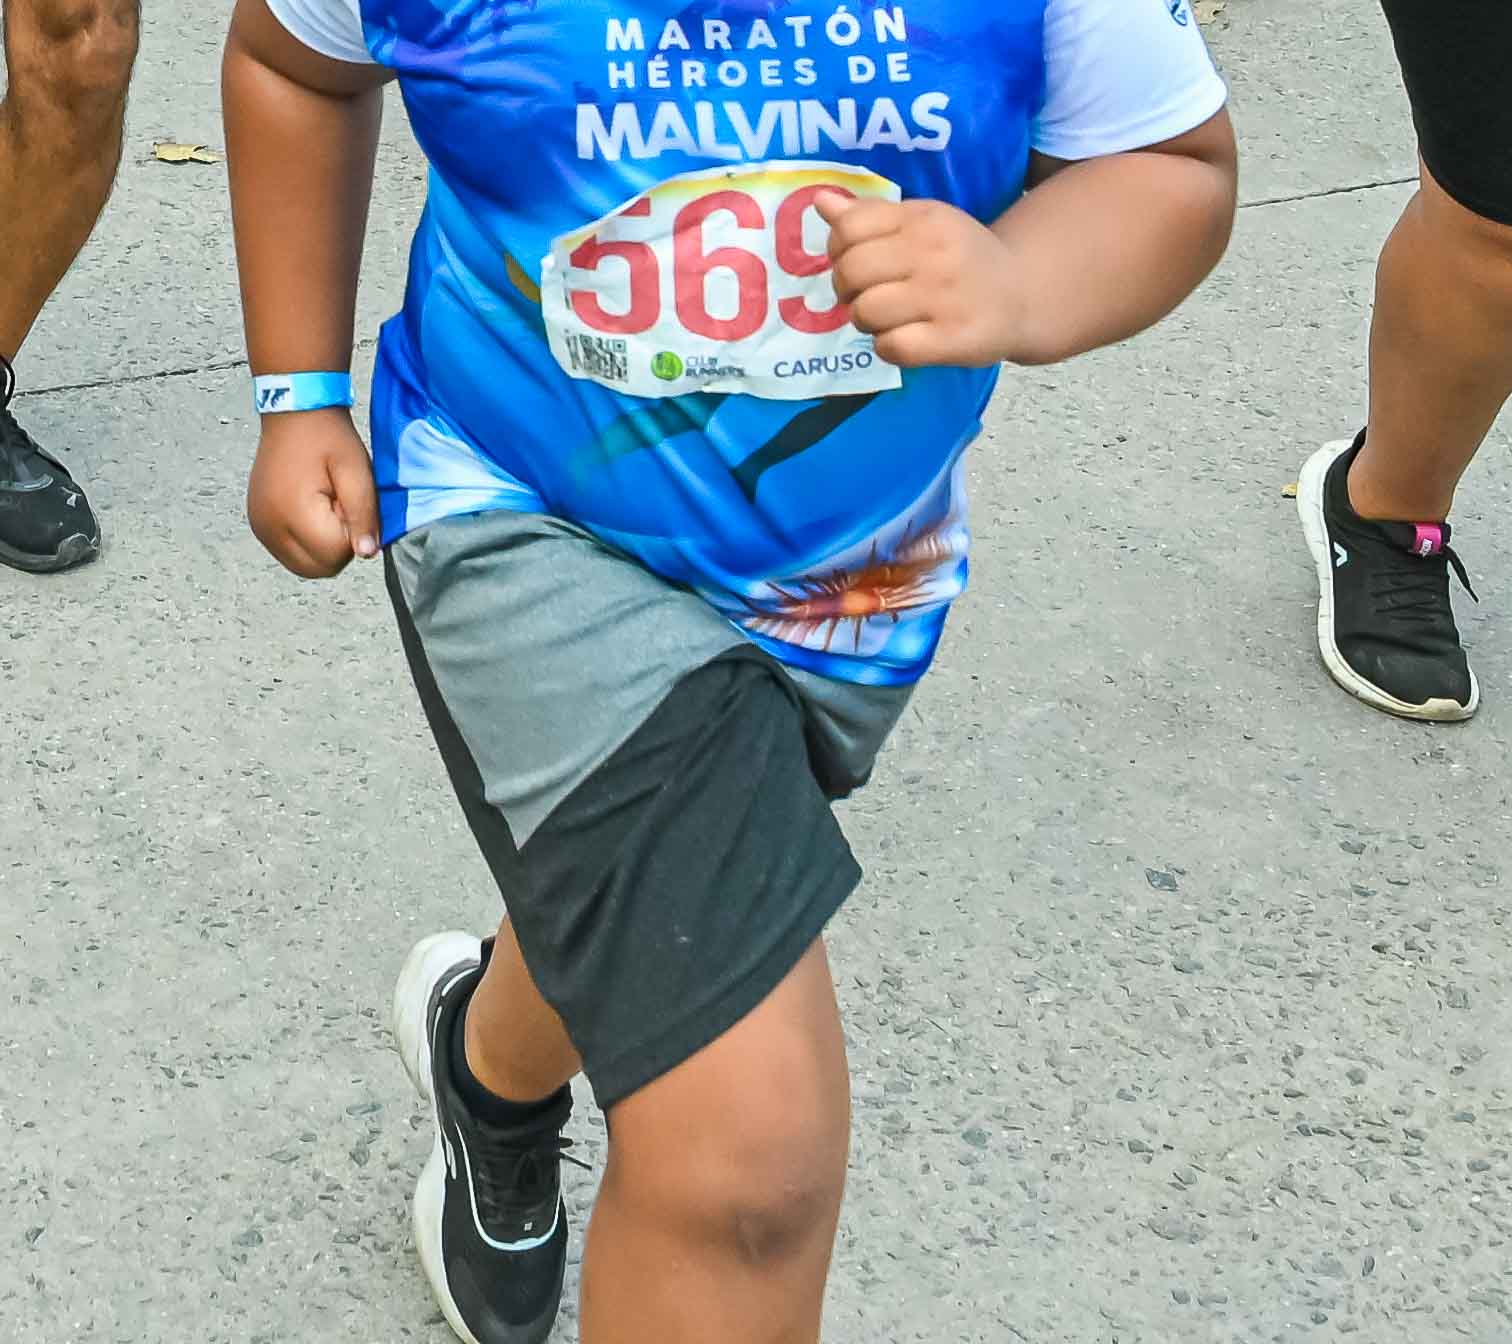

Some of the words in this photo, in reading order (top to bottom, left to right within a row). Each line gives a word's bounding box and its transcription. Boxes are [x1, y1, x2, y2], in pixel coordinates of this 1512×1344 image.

[606, 4, 910, 53] MARATÓN
[608, 55, 822, 90] HÉROES
[847, 52, 915, 84] DE
[576, 92, 954, 161] MALVINAS
[569, 184, 860, 342] 569
[773, 350, 874, 378] CARUSO
